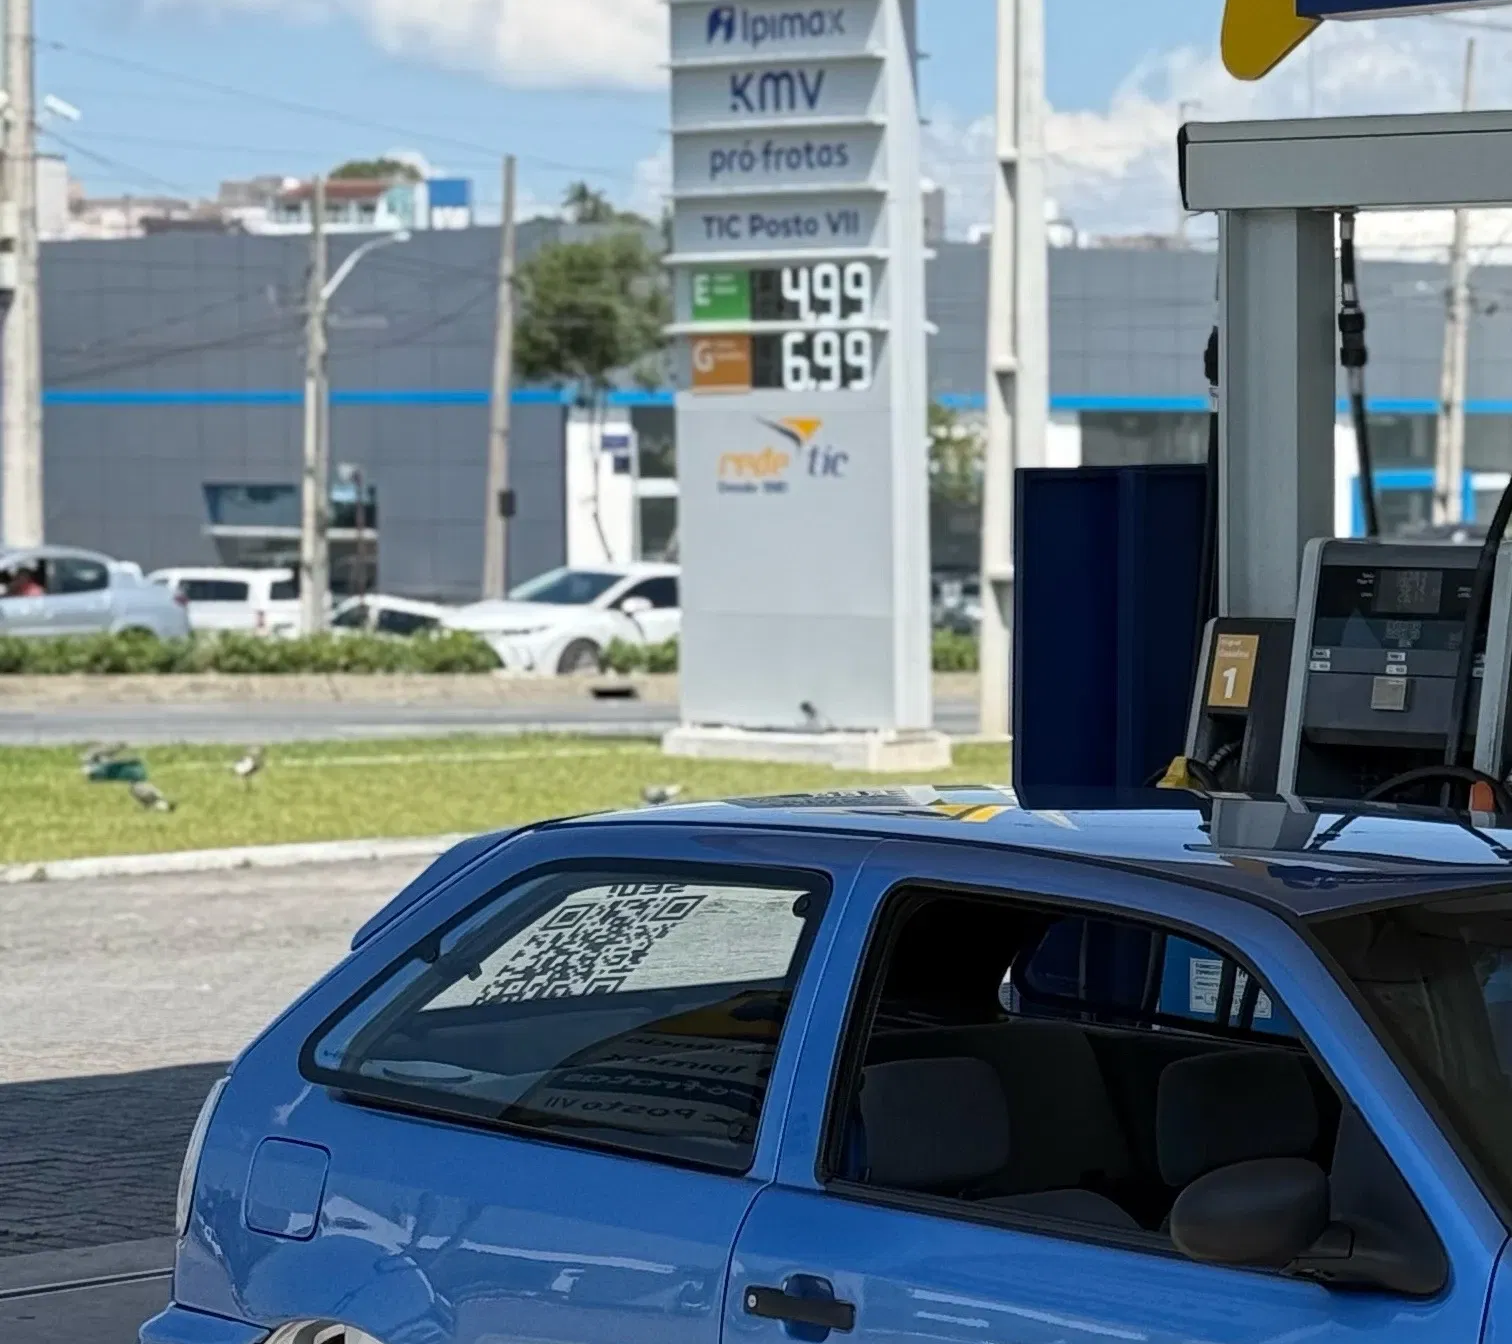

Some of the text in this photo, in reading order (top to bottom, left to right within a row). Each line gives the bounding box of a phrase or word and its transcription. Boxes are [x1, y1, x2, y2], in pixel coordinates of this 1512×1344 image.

[741, 8, 845, 49] Ipimax
[730, 68, 825, 113] KMV
[703, 210, 860, 240] TIC Posto VII
[694, 274, 711, 306] E
[693, 339, 715, 373] G
[1223, 667, 1237, 699] 1
